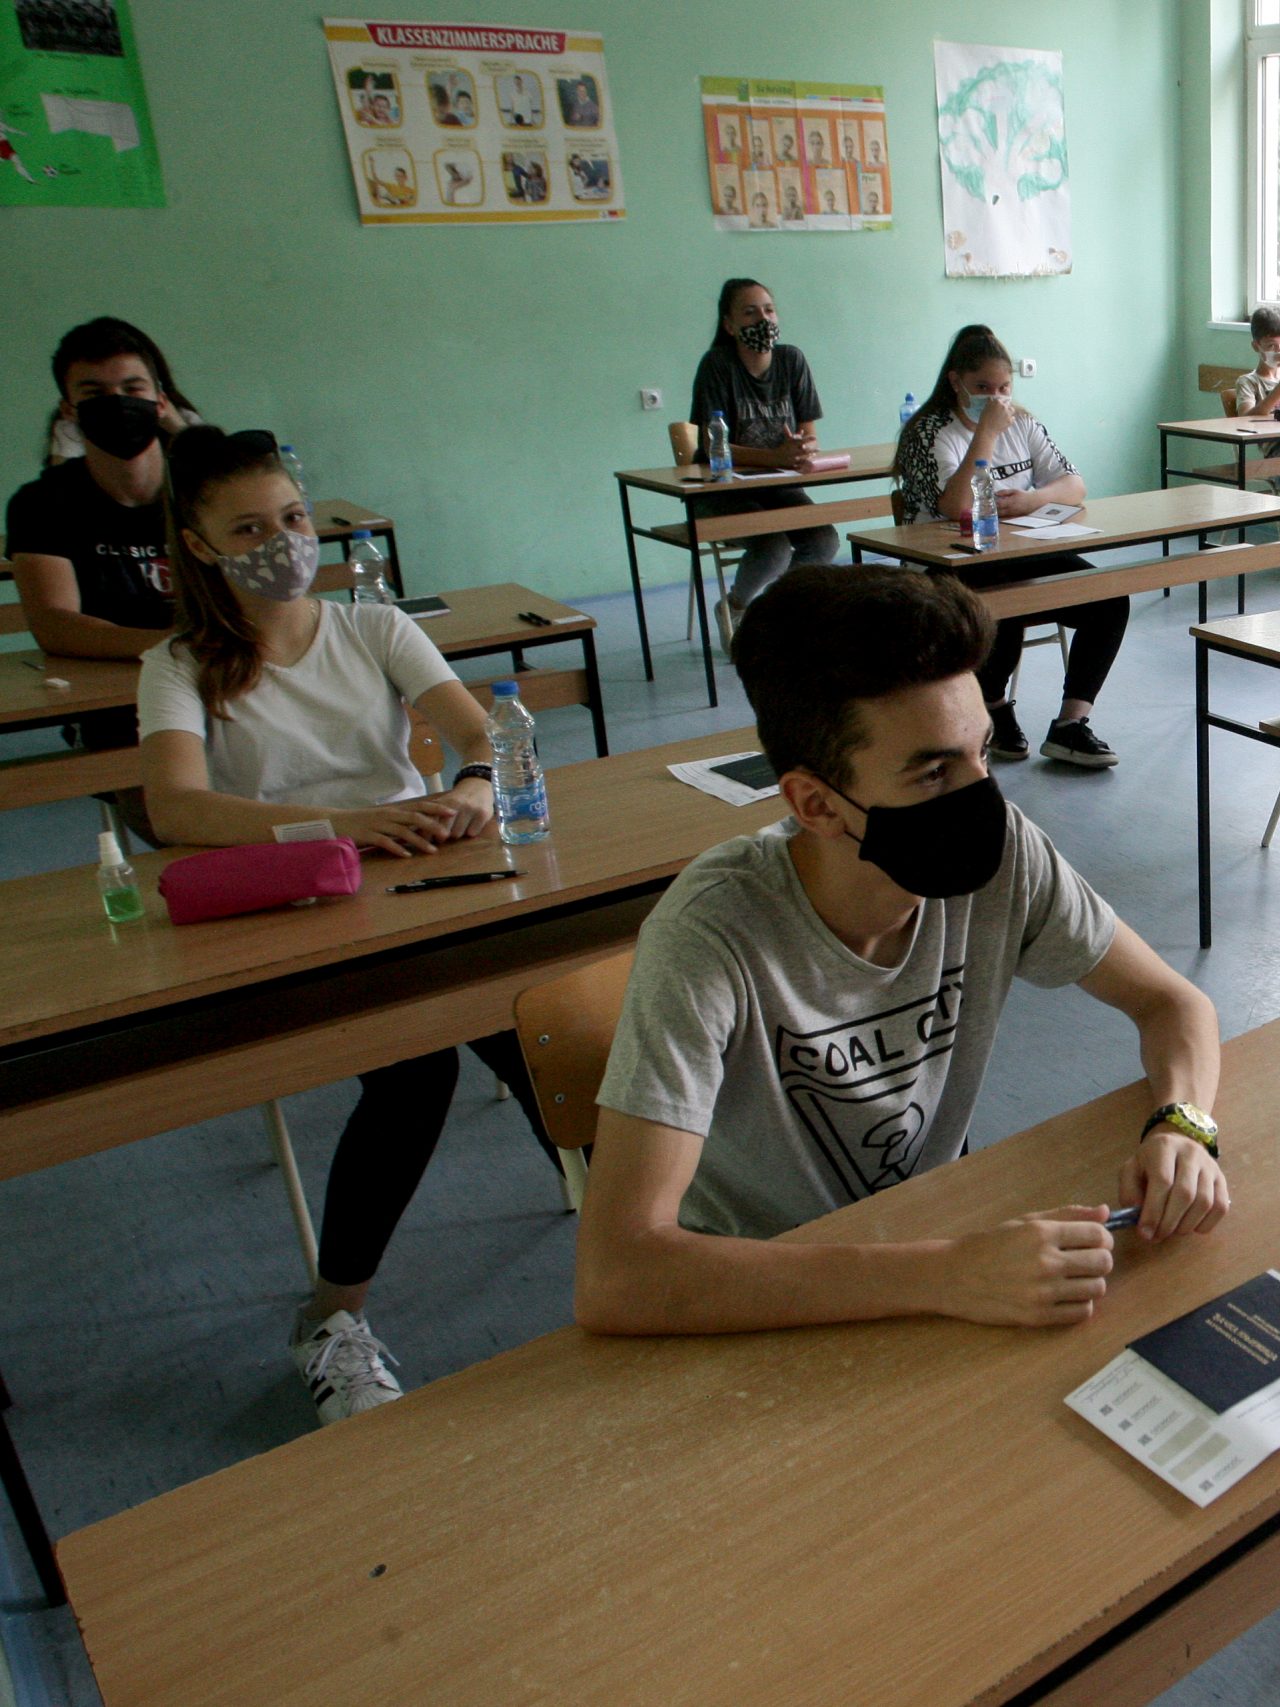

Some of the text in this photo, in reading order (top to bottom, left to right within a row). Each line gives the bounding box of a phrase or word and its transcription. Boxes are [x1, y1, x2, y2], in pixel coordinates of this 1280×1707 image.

[376, 26, 560, 51] KLASSENZIMMERSPRACHE
[96, 544, 157, 558] CLSIC
[789, 1029, 904, 1077] COAL
